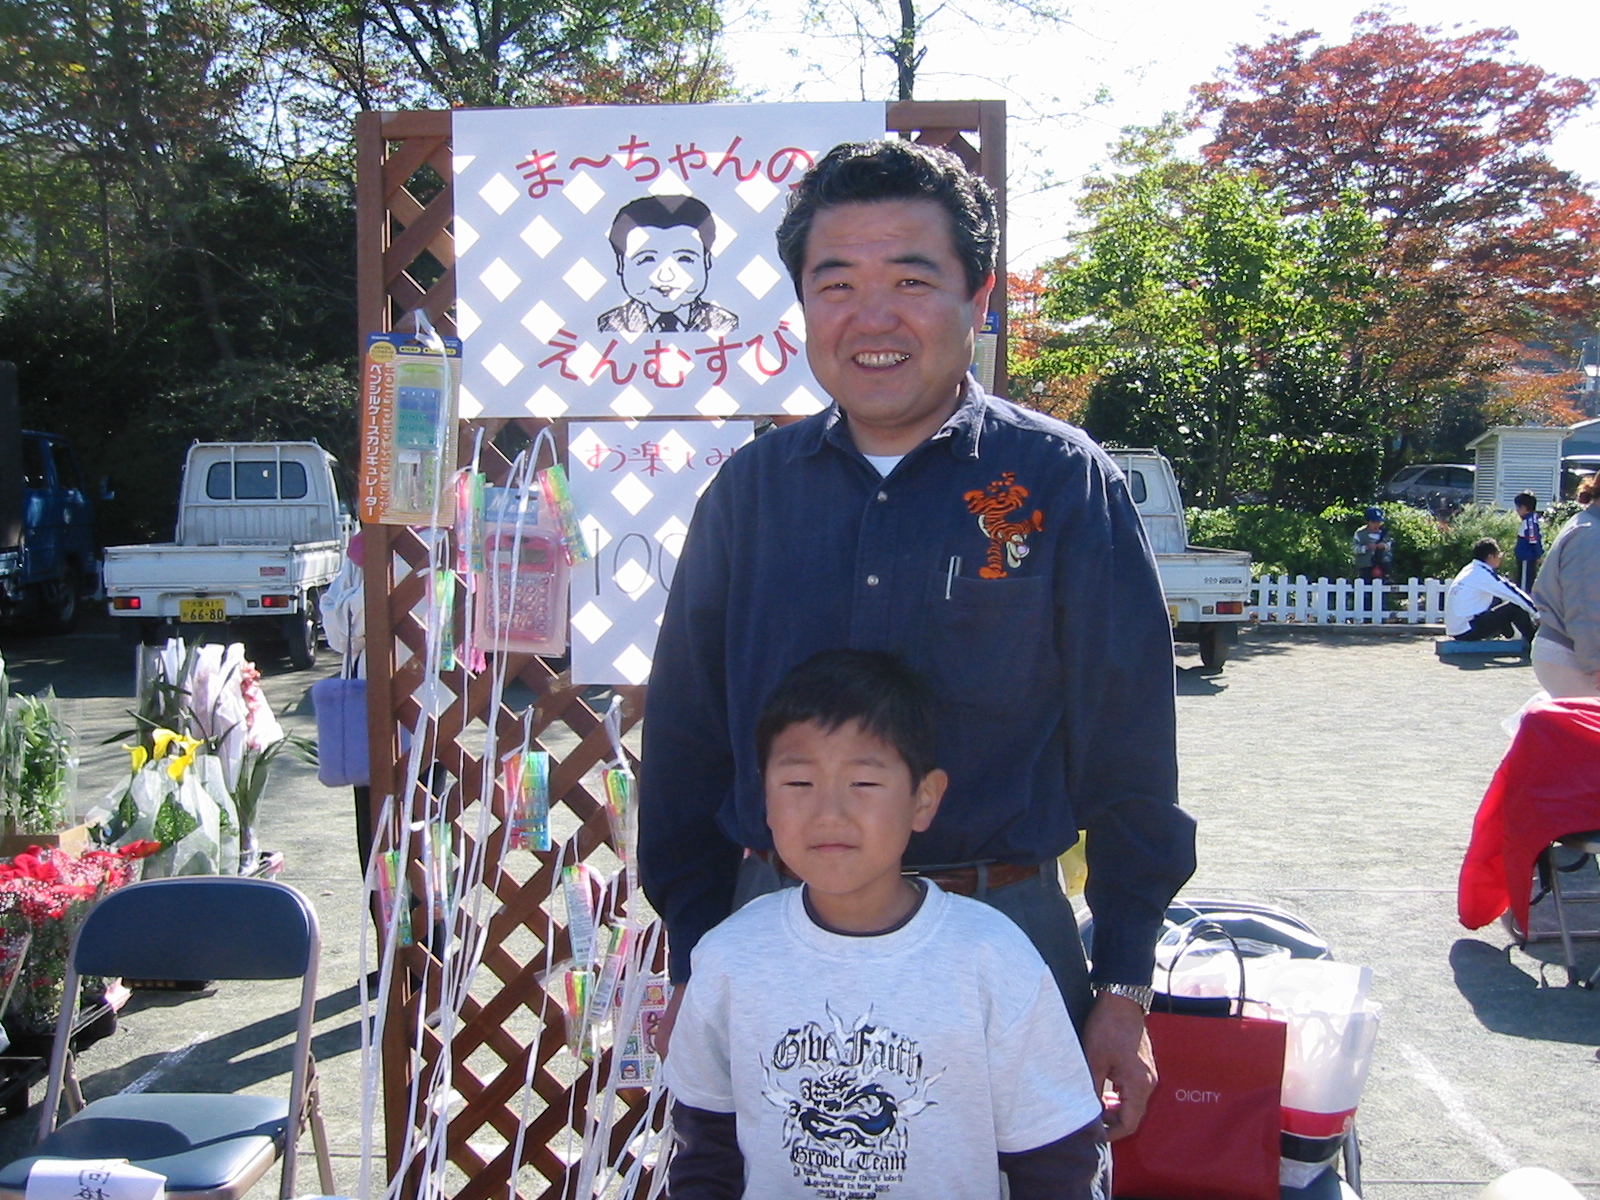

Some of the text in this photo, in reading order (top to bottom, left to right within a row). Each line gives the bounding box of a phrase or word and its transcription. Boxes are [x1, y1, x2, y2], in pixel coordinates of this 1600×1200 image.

[537, 320, 800, 388] えんむすび
[772, 1020, 922, 1085] Give Faith
[1175, 1089, 1221, 1103] OICITY
[856, 1150, 907, 1171] Team
